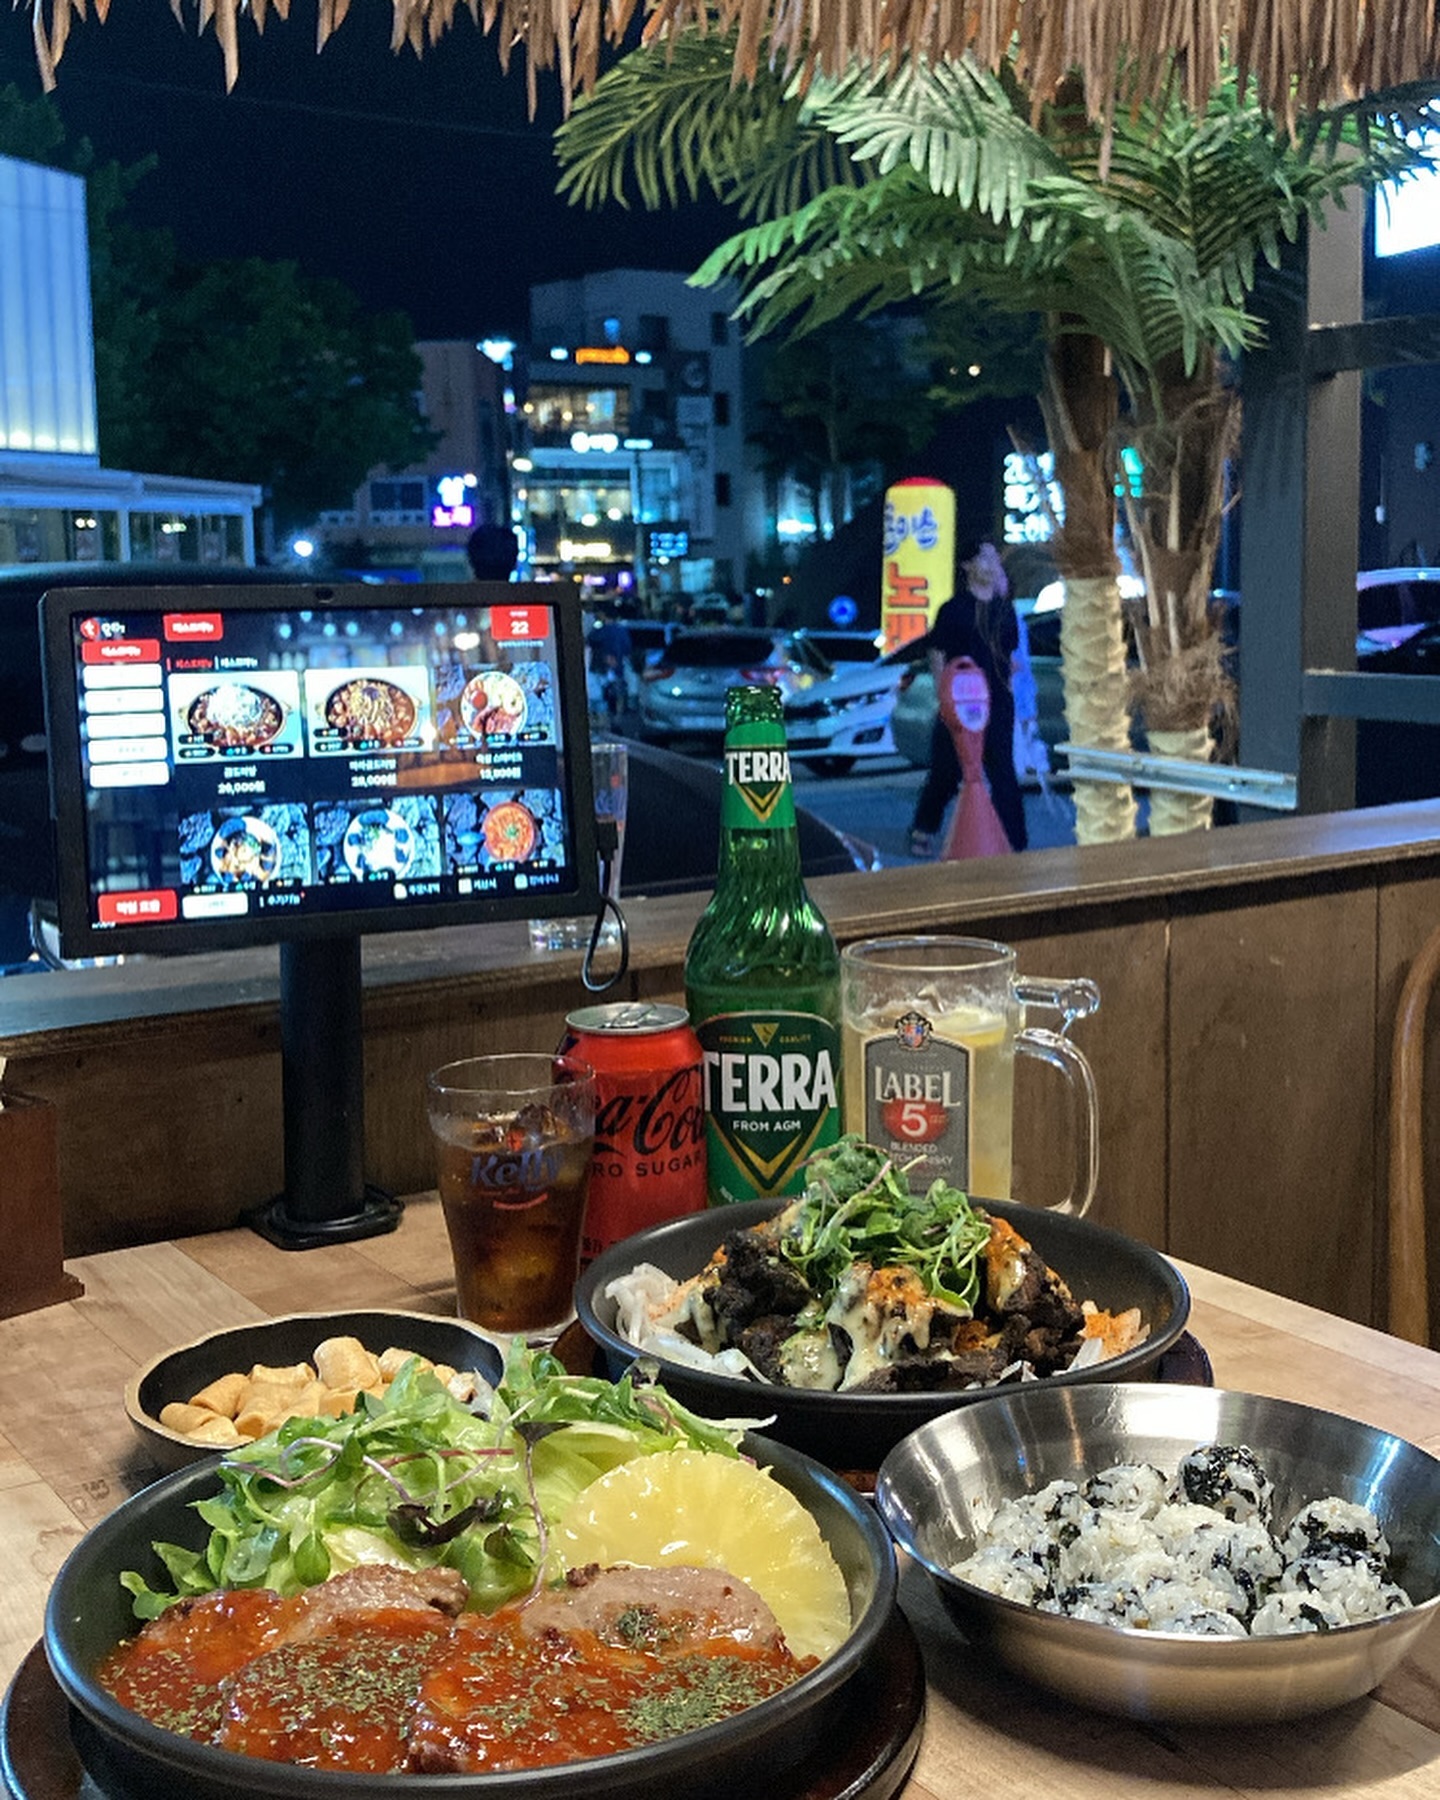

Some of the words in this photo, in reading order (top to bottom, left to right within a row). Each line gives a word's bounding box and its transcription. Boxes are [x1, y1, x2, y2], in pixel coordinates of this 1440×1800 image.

[511, 620, 529, 635] 22
[725, 751, 792, 785] TERRA
[703, 1050, 838, 1112] TERRA
[875, 1066, 961, 1107] LABEL
[733, 1120, 769, 1132] FROM
[773, 1119, 801, 1132] AGM
[901, 1104, 928, 1137] 5
[592, 1163, 623, 1178] RO
